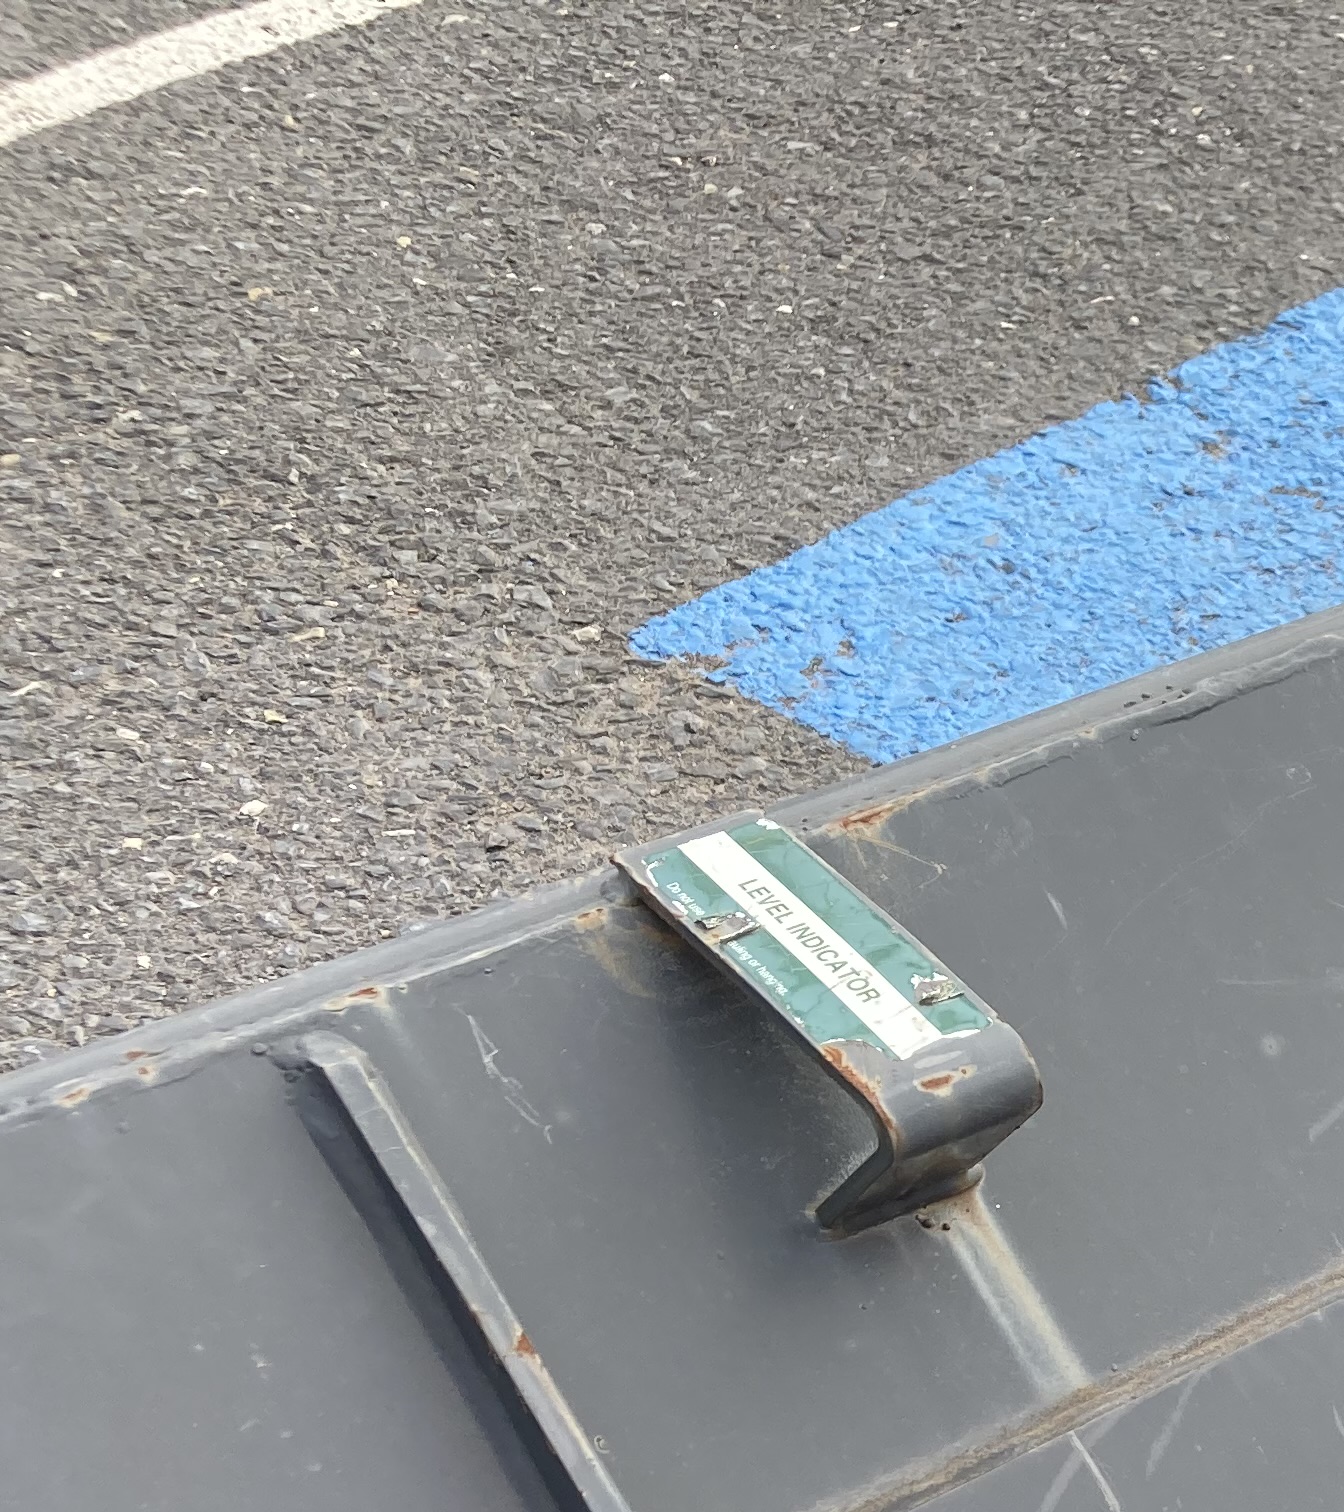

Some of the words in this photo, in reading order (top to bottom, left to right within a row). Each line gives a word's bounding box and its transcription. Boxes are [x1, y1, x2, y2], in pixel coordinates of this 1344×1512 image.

[666, 881, 682, 894] Do
[677, 891, 695, 904] not
[689, 903, 706, 916] use
[726, 940, 753, 961] auling
[737, 878, 794, 924] LEVEL
[786, 922, 880, 1002] INDICATOR
